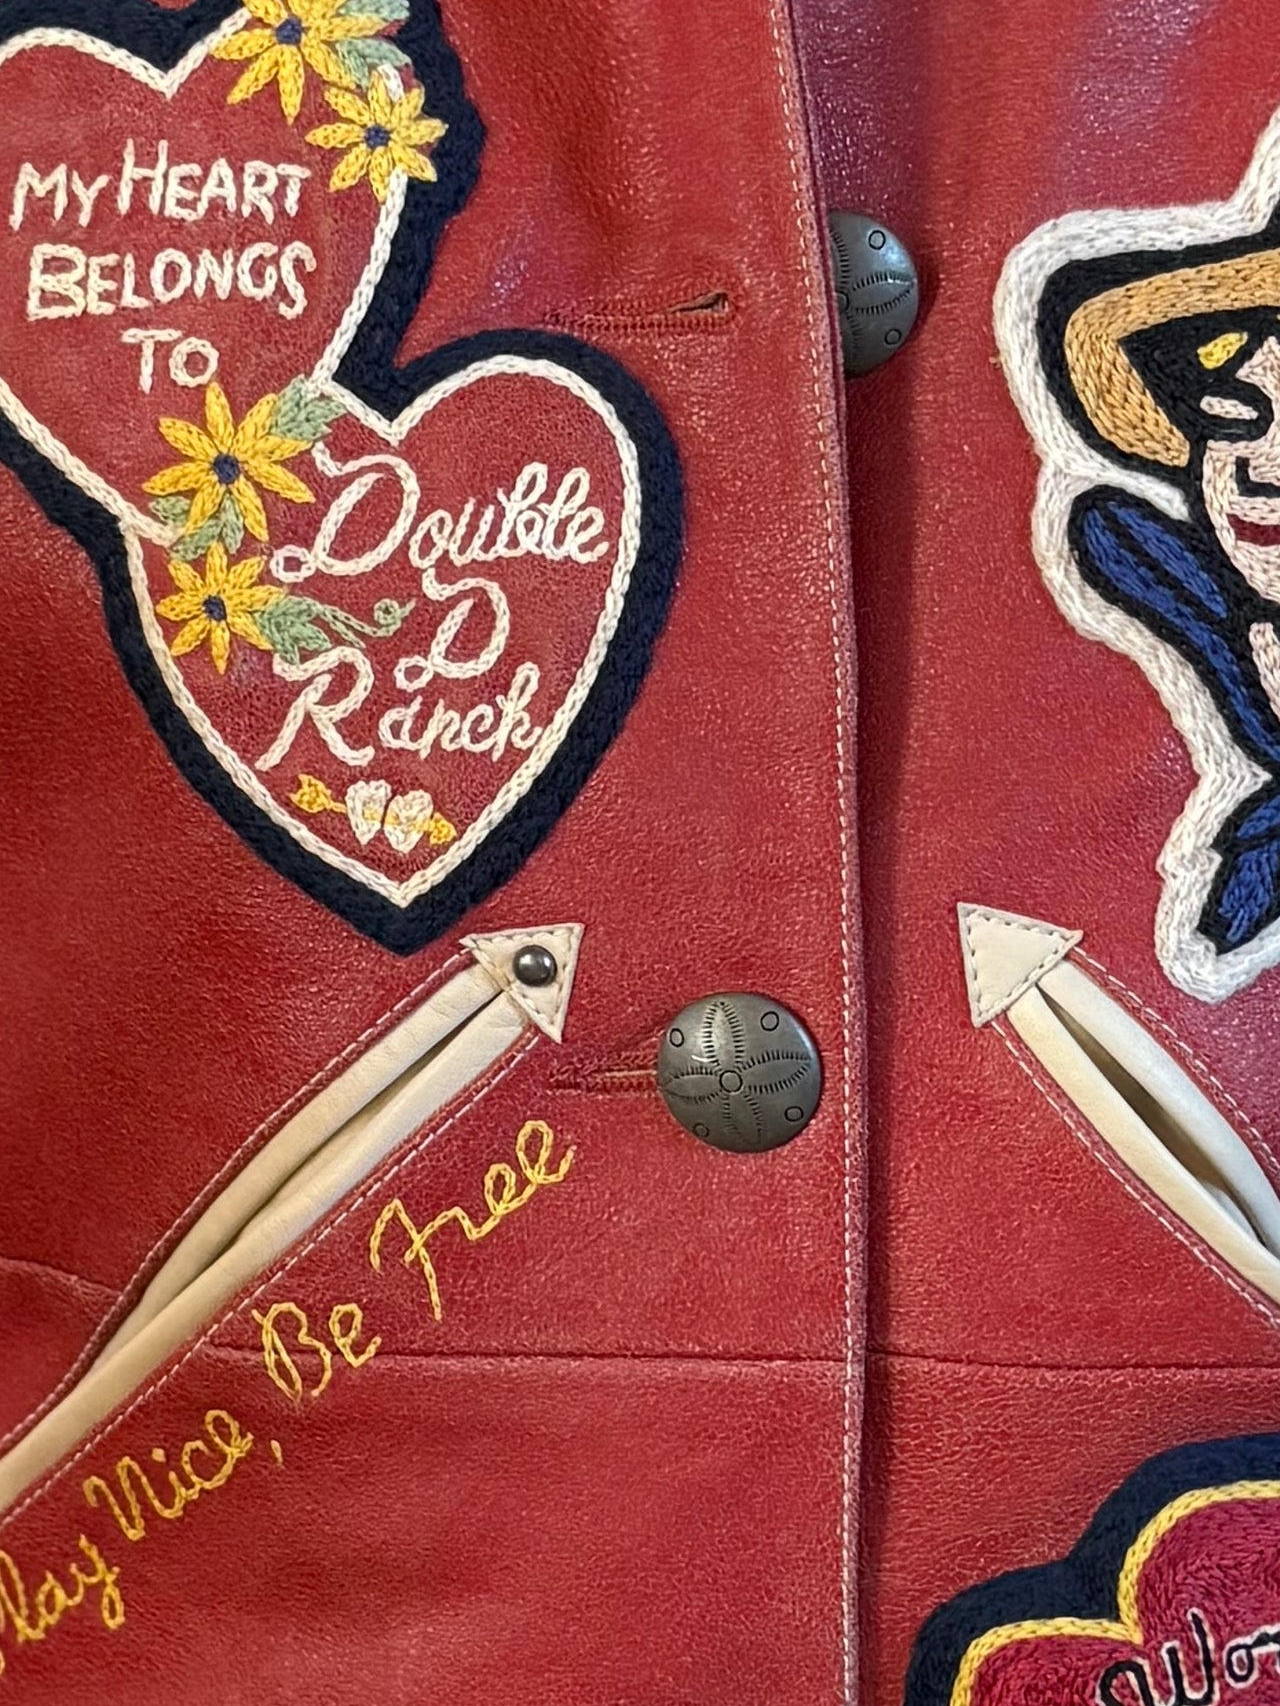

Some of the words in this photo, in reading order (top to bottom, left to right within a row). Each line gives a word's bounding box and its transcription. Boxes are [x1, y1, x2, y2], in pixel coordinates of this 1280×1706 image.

[9, 163, 109, 230] MY
[117, 139, 311, 223] HEART
[27, 243, 316, 320] BELONGS
[122, 328, 218, 393] TO
[272, 442, 609, 582] Double
[395, 569, 508, 690] D
[256, 646, 547, 770] Ranch
[252, 1302, 382, 1400] Be
[369, 1121, 576, 1321] Free
